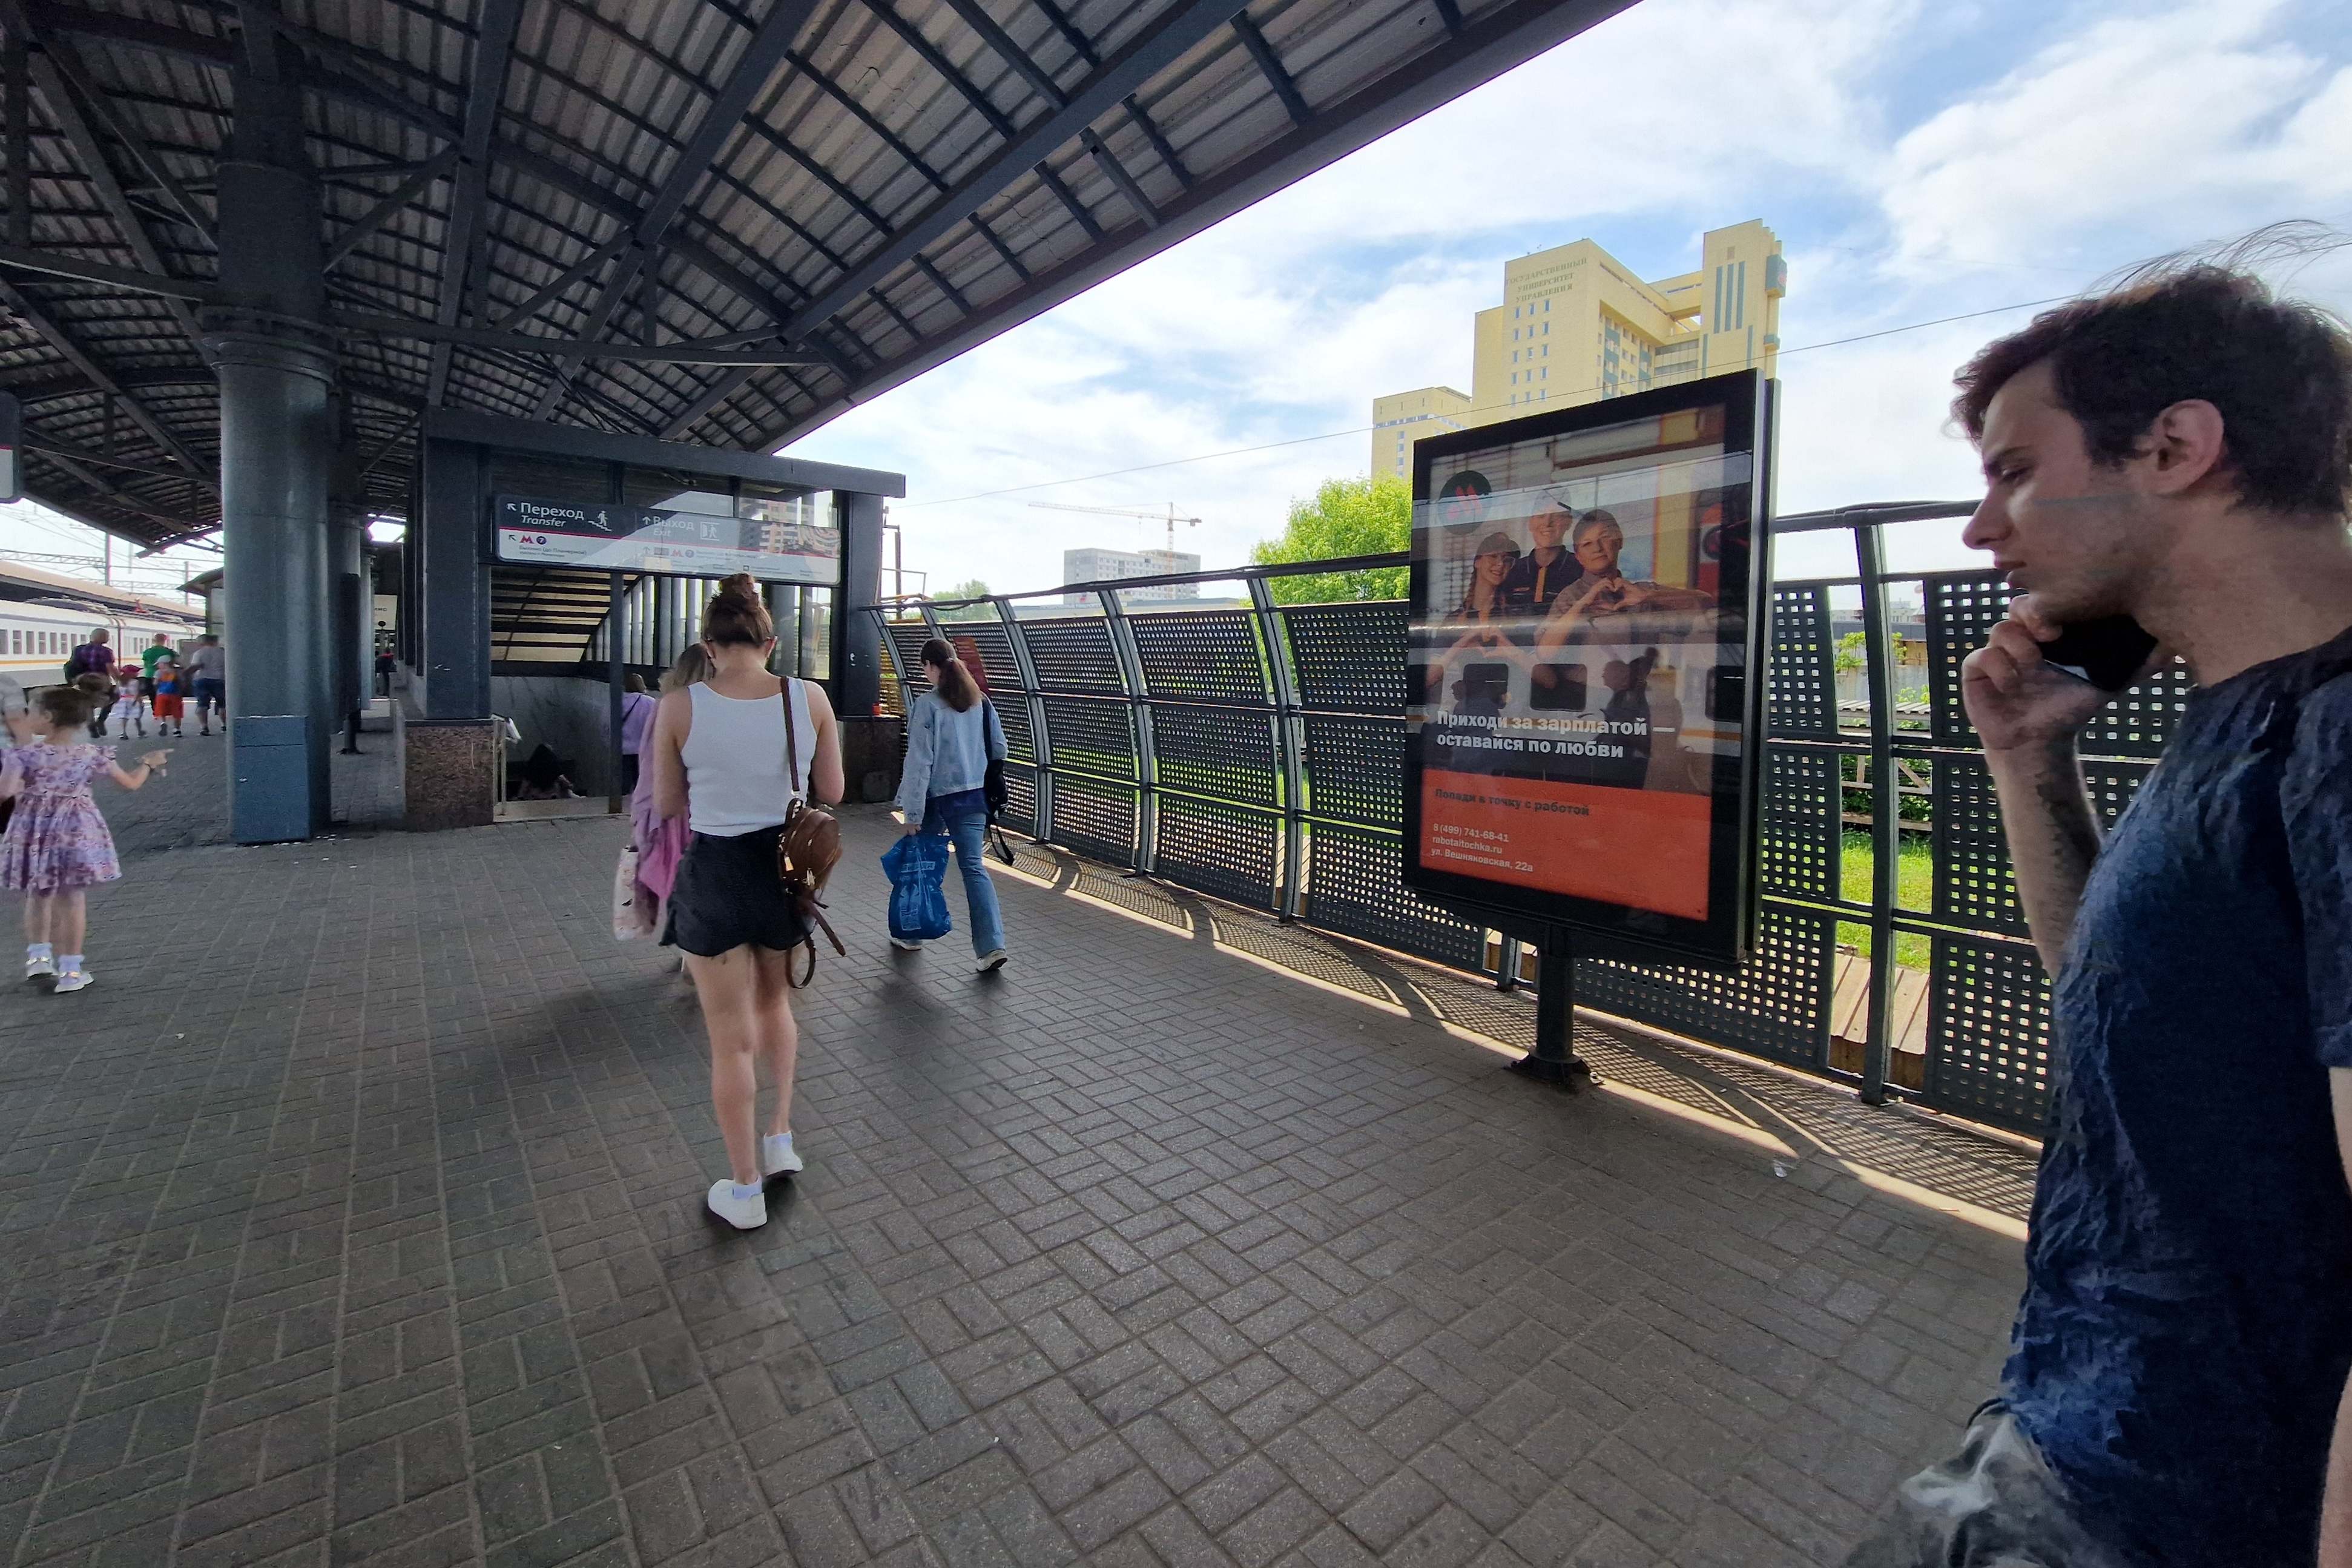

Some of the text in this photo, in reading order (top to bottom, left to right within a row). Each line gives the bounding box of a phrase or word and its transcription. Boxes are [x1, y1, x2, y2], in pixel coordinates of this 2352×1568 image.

[1507, 257, 1587, 285] ГОСУДАРСТВЕННЫЙ
[1517, 272, 1574, 292] УНИВЕРСИТЕТ
[1515, 283, 1573, 302] УПРАВЛЕНИЯ
[521, 502, 585, 521] Переход
[521, 515, 567, 527] Transfer
[653, 516, 694, 531] Выход
[653, 528, 671, 536] Exit
[1437, 711, 1508, 731] Приходи
[1511, 717, 1533, 730] за
[1537, 717, 1647, 736] зарплатой
[1437, 734, 1624, 758] оставайся по любви
[1435, 789, 1476, 804] Попади
[1478, 795, 1486, 803] в
[1489, 796, 1521, 810] точку
[1534, 802, 1590, 816] работой
[1440, 825, 1462, 836] (499)
[1464, 828, 1509, 843] 741-68-41
[1444, 849, 1512, 869] Вешняковская,
[1515, 861, 1533, 872] 22а
